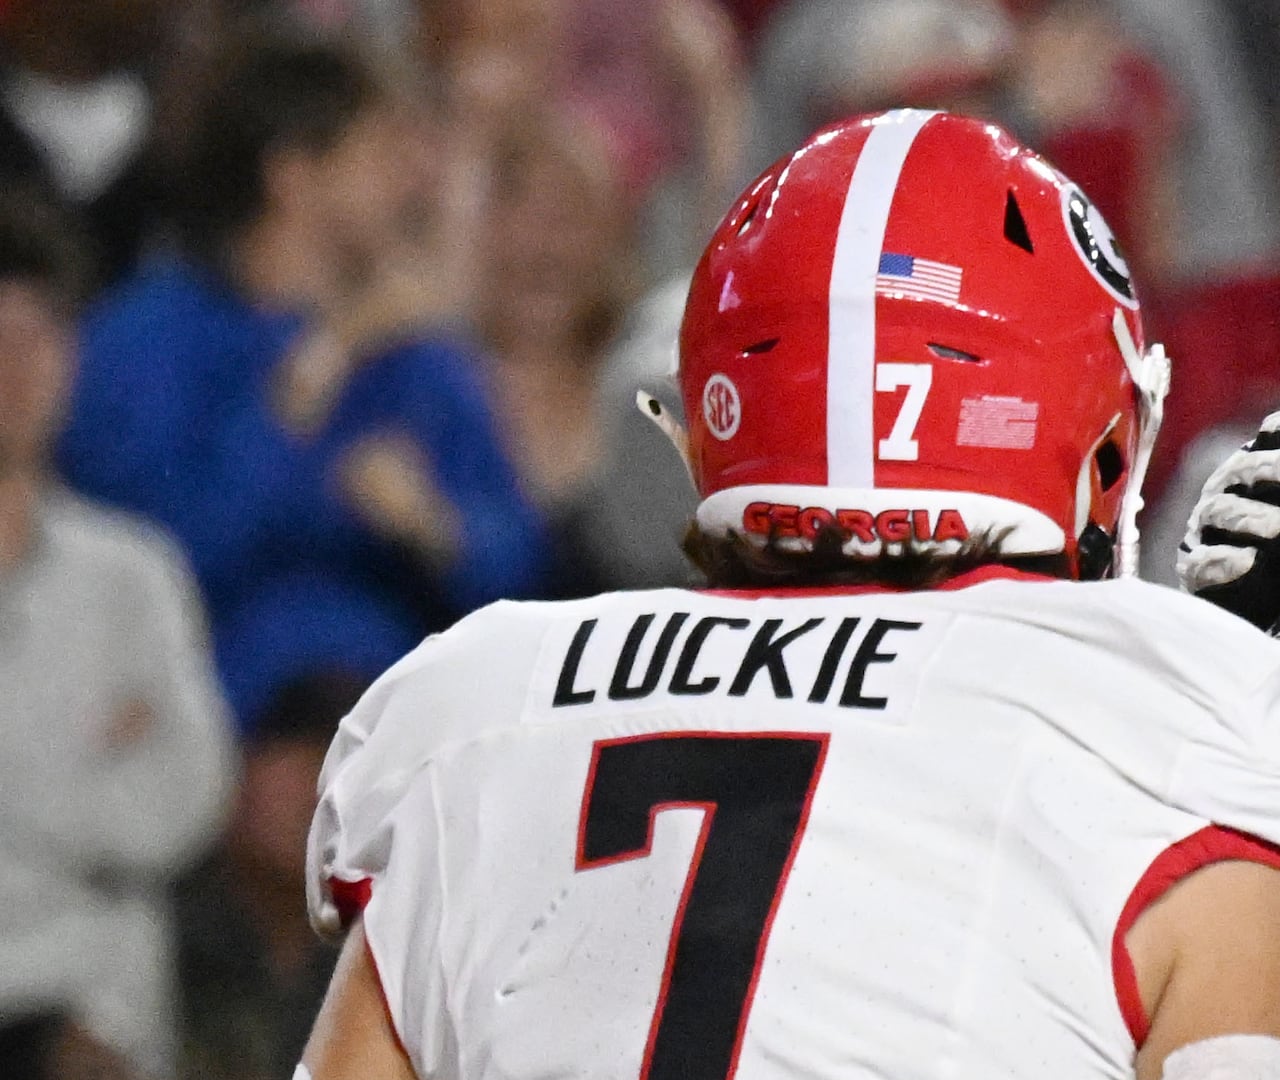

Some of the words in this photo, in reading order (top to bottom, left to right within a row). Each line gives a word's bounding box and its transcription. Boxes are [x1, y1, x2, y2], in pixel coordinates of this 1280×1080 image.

[873, 362, 934, 461] 7
[742, 501, 970, 543] GEORGIA
[552, 612, 923, 710] LUCKIE
